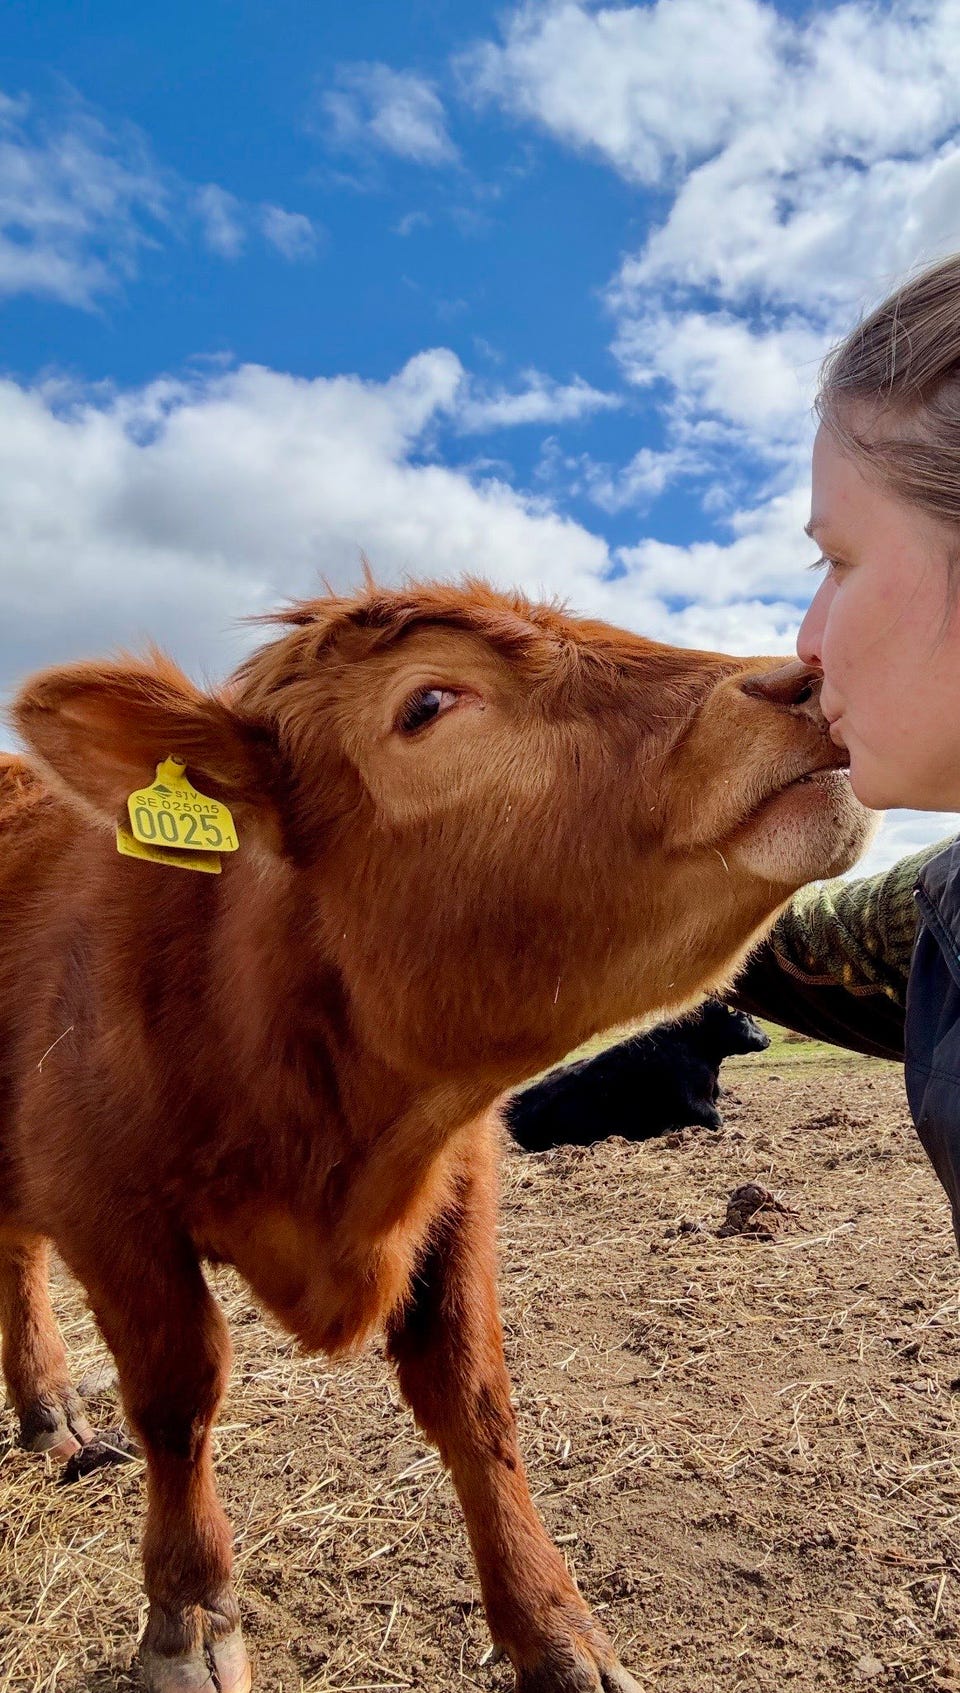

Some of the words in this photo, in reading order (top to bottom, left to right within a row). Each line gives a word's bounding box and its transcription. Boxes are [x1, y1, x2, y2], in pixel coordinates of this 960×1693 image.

[136, 795, 158, 808] SE
[162, 800, 219, 813] 025015
[135, 806, 223, 847] 0025
[226, 836, 233, 848] 1
